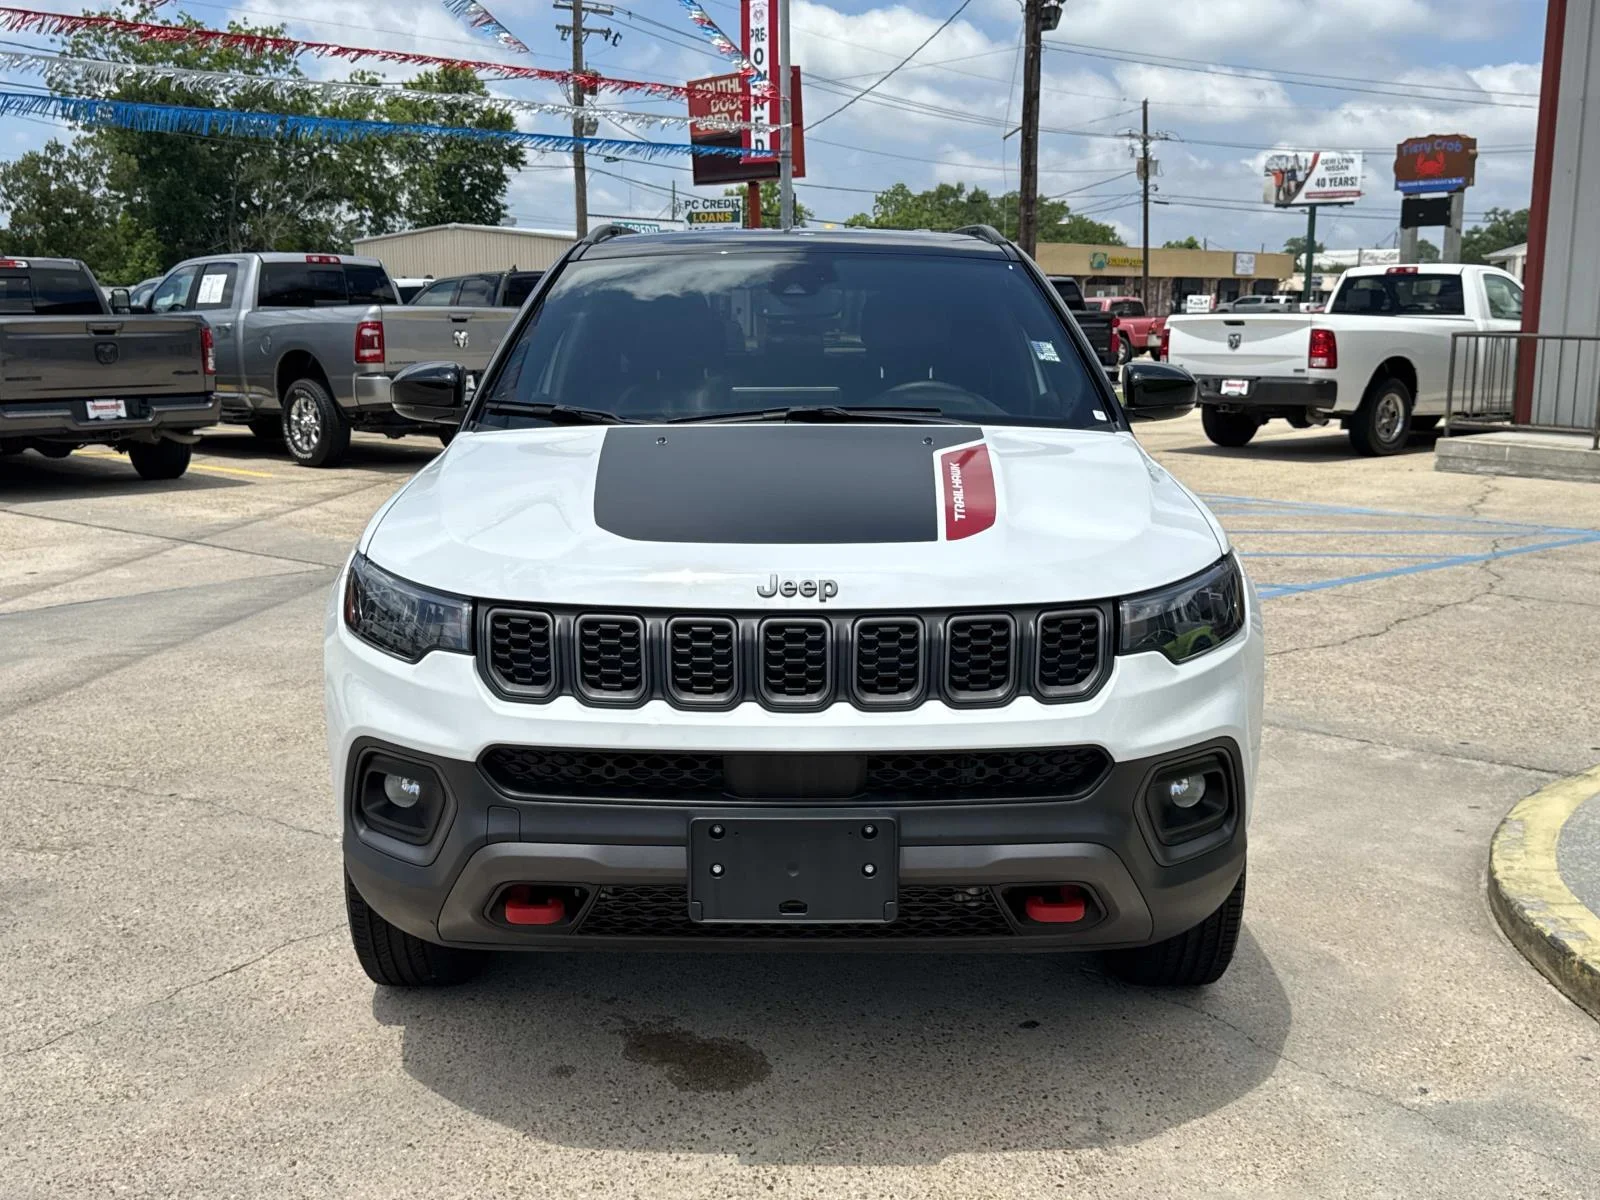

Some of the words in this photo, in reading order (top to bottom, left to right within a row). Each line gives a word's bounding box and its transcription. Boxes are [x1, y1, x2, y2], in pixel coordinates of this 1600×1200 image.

[1315, 177, 1326, 188] 40
[1328, 176, 1358, 187] YEARS!
[684, 200, 699, 210] PC
[702, 198, 740, 210] CREDIT
[692, 212, 733, 223] LOANS
[949, 462, 966, 522] TRAILHAWK
[756, 573, 839, 603] Jeep
